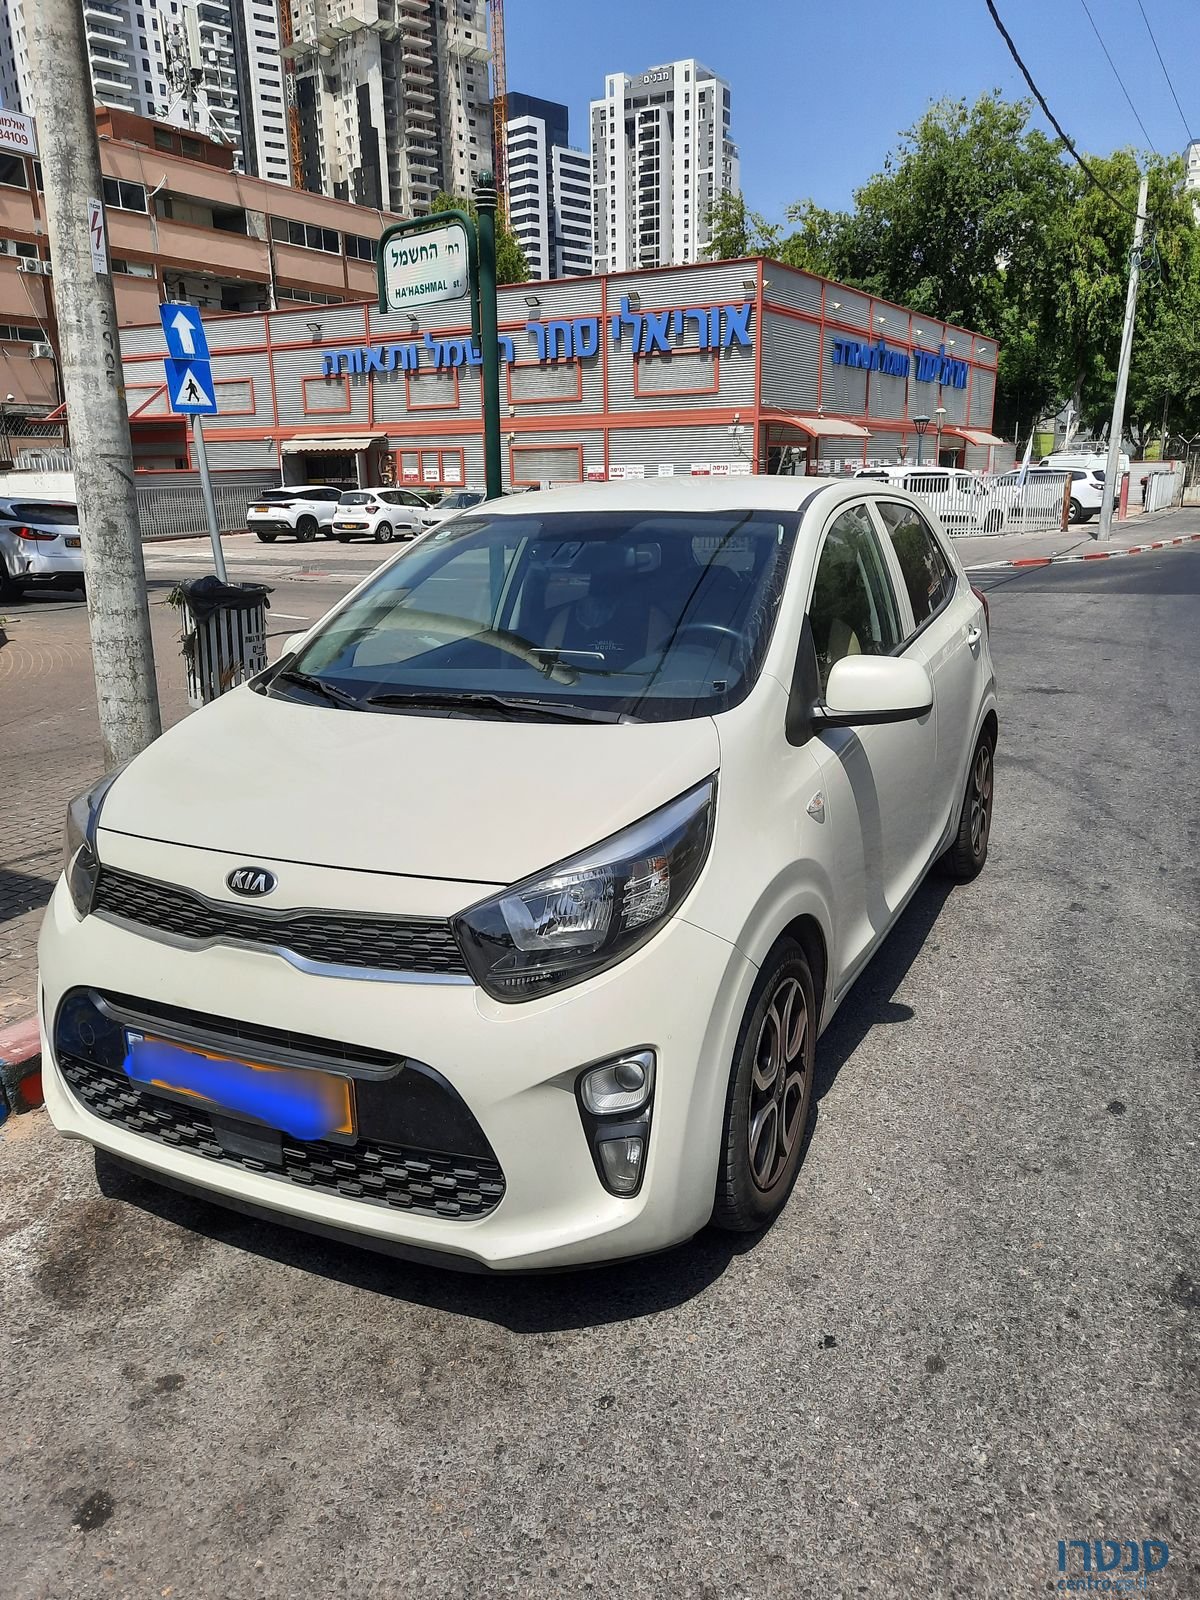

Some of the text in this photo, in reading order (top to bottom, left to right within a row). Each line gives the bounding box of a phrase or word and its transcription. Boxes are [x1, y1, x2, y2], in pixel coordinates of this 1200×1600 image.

[643, 71, 669, 84] מבנים
[0, 117, 26, 132] אולמו
[391, 242, 438, 268] החשמל
[395, 280, 447, 299] HA'HASHMAL
[611, 297, 752, 354] אוריאלי
[525, 318, 598, 361] סחר
[321, 344, 419, 375] ותאורה
[231, 870, 266, 892] KIA
